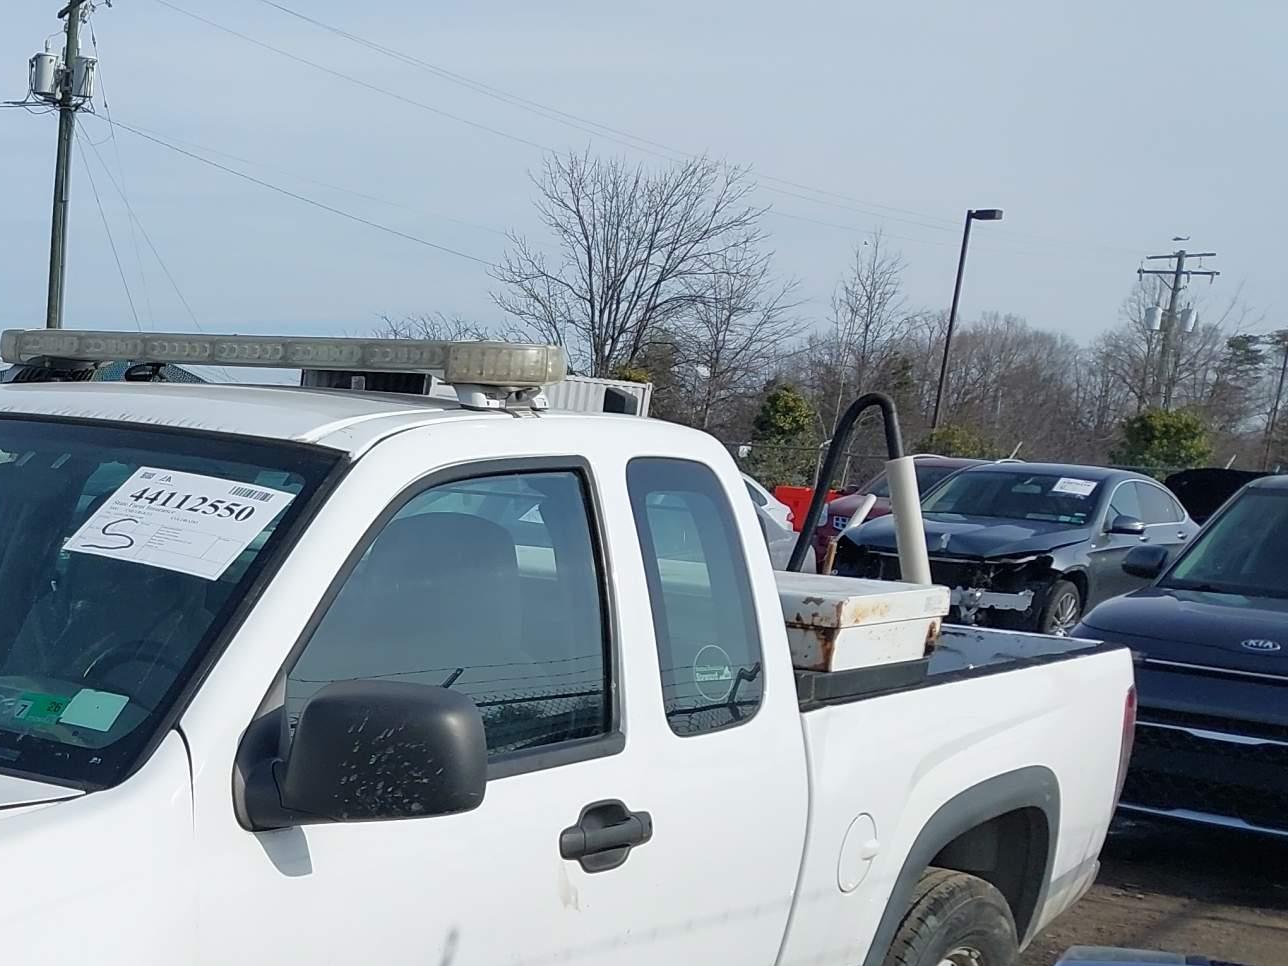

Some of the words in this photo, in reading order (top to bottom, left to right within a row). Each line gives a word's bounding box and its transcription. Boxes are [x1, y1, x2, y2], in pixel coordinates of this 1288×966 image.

[129, 487, 256, 522] 44112550
[79, 518, 139, 550] S
[15, 703, 28, 717] 7
